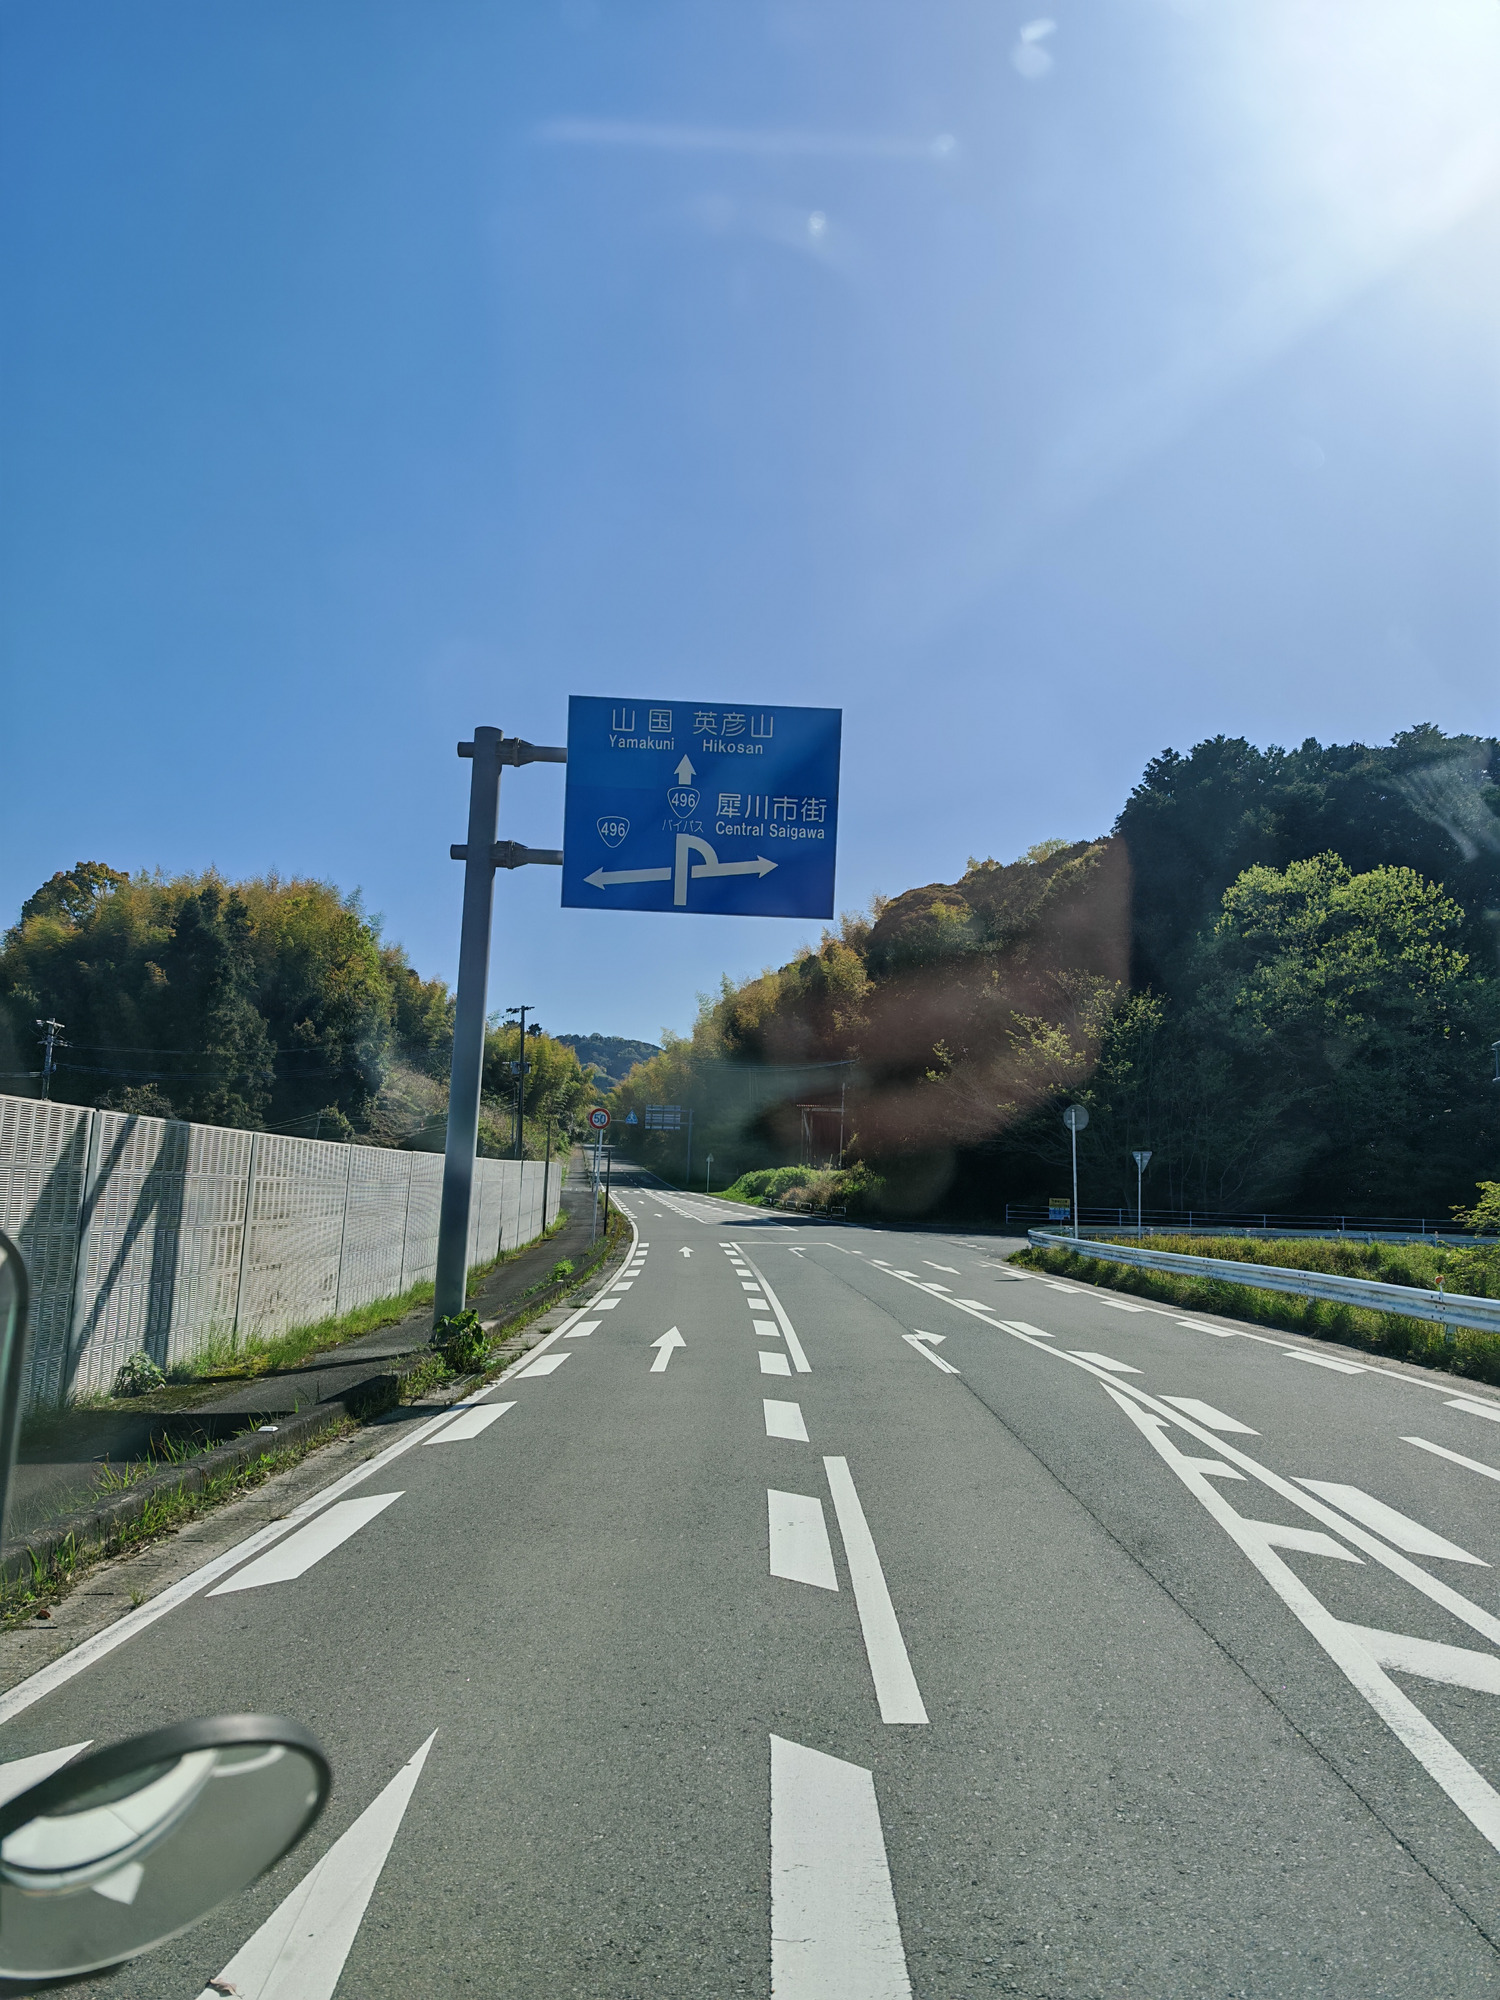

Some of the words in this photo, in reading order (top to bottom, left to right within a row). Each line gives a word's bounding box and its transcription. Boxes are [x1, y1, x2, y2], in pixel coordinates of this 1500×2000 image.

[612, 707, 672, 733] 山国
[692, 711, 774, 739] 英彦山
[609, 734, 675, 751] Yamakuni
[703, 739, 763, 755] Hikosan
[671, 793, 696, 808] 496
[715, 792, 827, 823] 犀川市街
[601, 822, 626, 836] 496
[662, 818, 704, 833] バイパス
[715, 821, 764, 837] Central
[769, 824, 825, 840] Saigawa
[593, 1113, 606, 1124] 50
